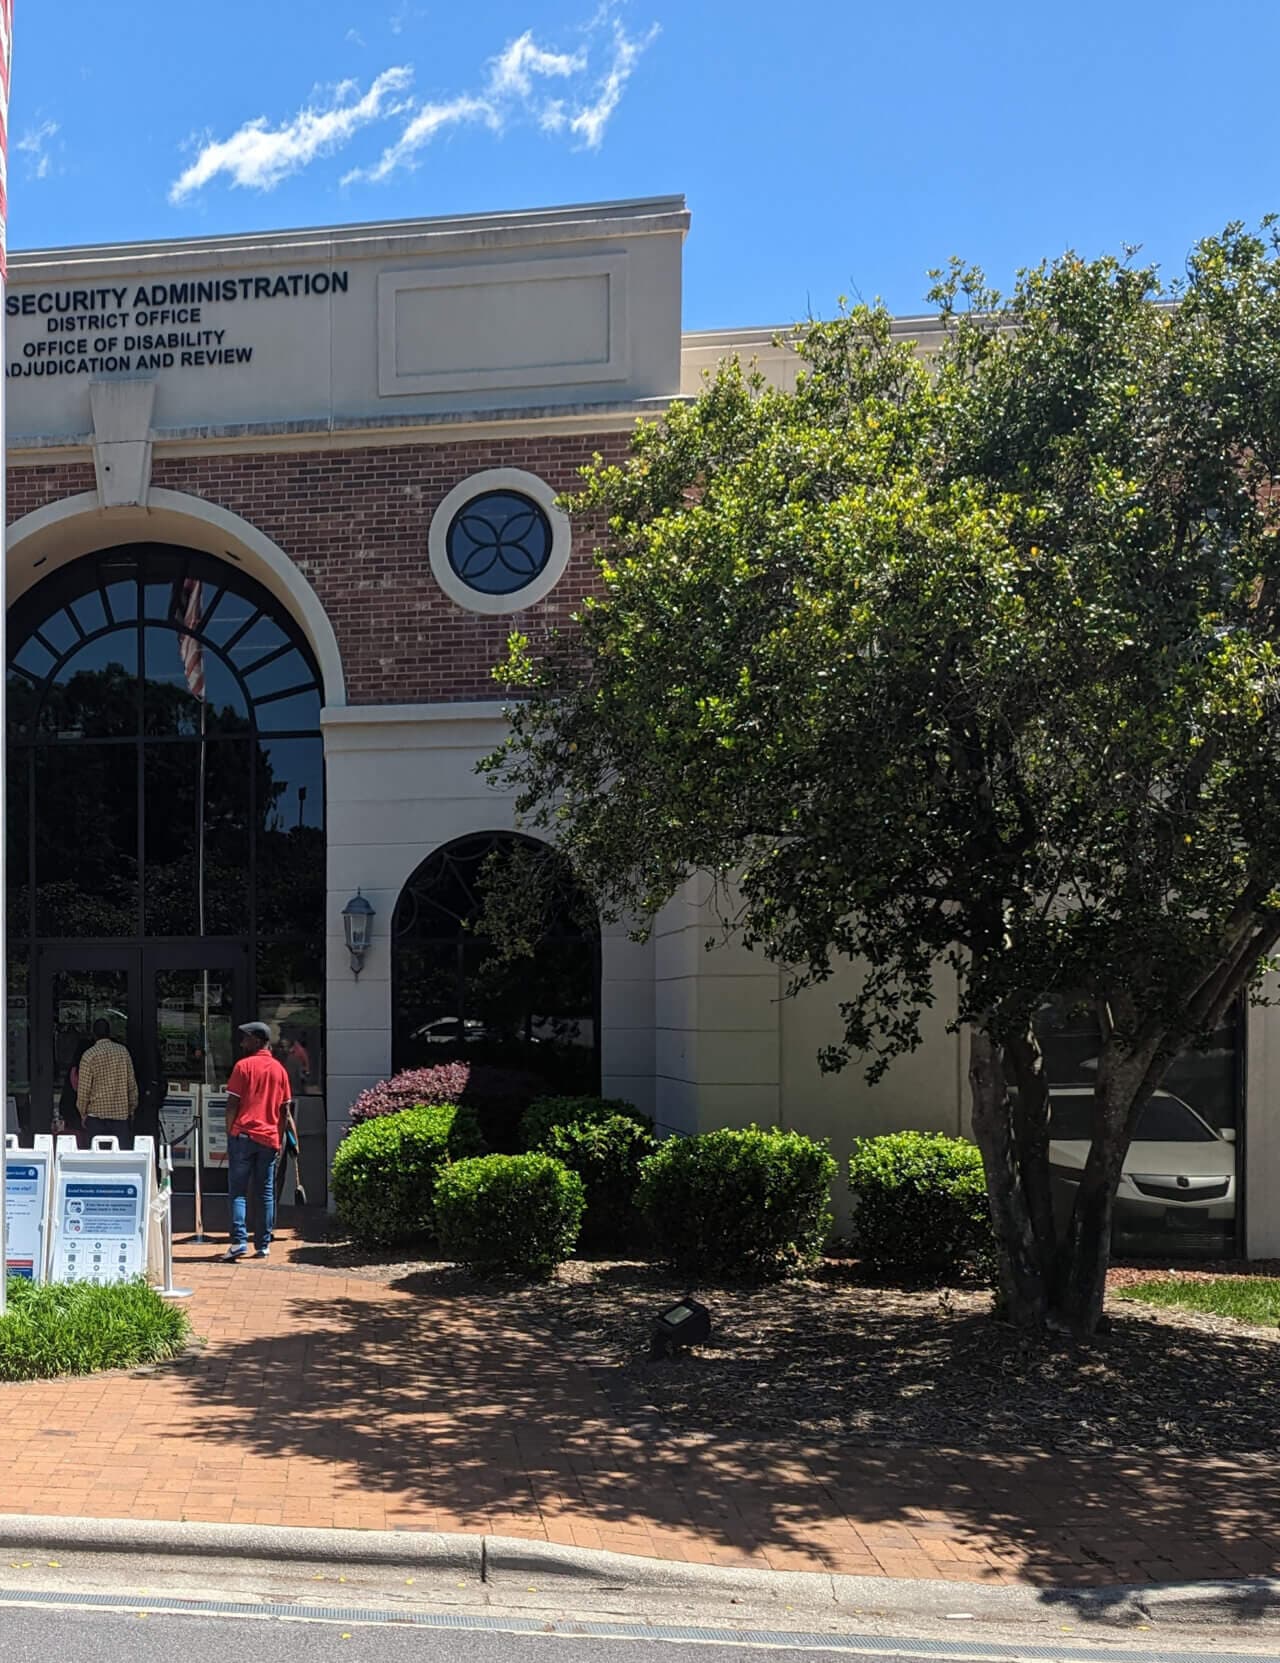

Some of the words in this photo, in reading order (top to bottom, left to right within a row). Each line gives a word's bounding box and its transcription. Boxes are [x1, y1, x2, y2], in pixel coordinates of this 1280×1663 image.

[6, 288, 127, 316] SECURITY
[133, 272, 348, 307] ADMINISTRATION
[48, 313, 129, 332] DISTRICT
[135, 308, 200, 326] OFFICE
[23, 339, 87, 357] OFFICE
[94, 337, 117, 353] OF
[124, 330, 224, 351] DISABILITY
[136, 353, 174, 370] AND
[181, 348, 252, 366] REVIEW
